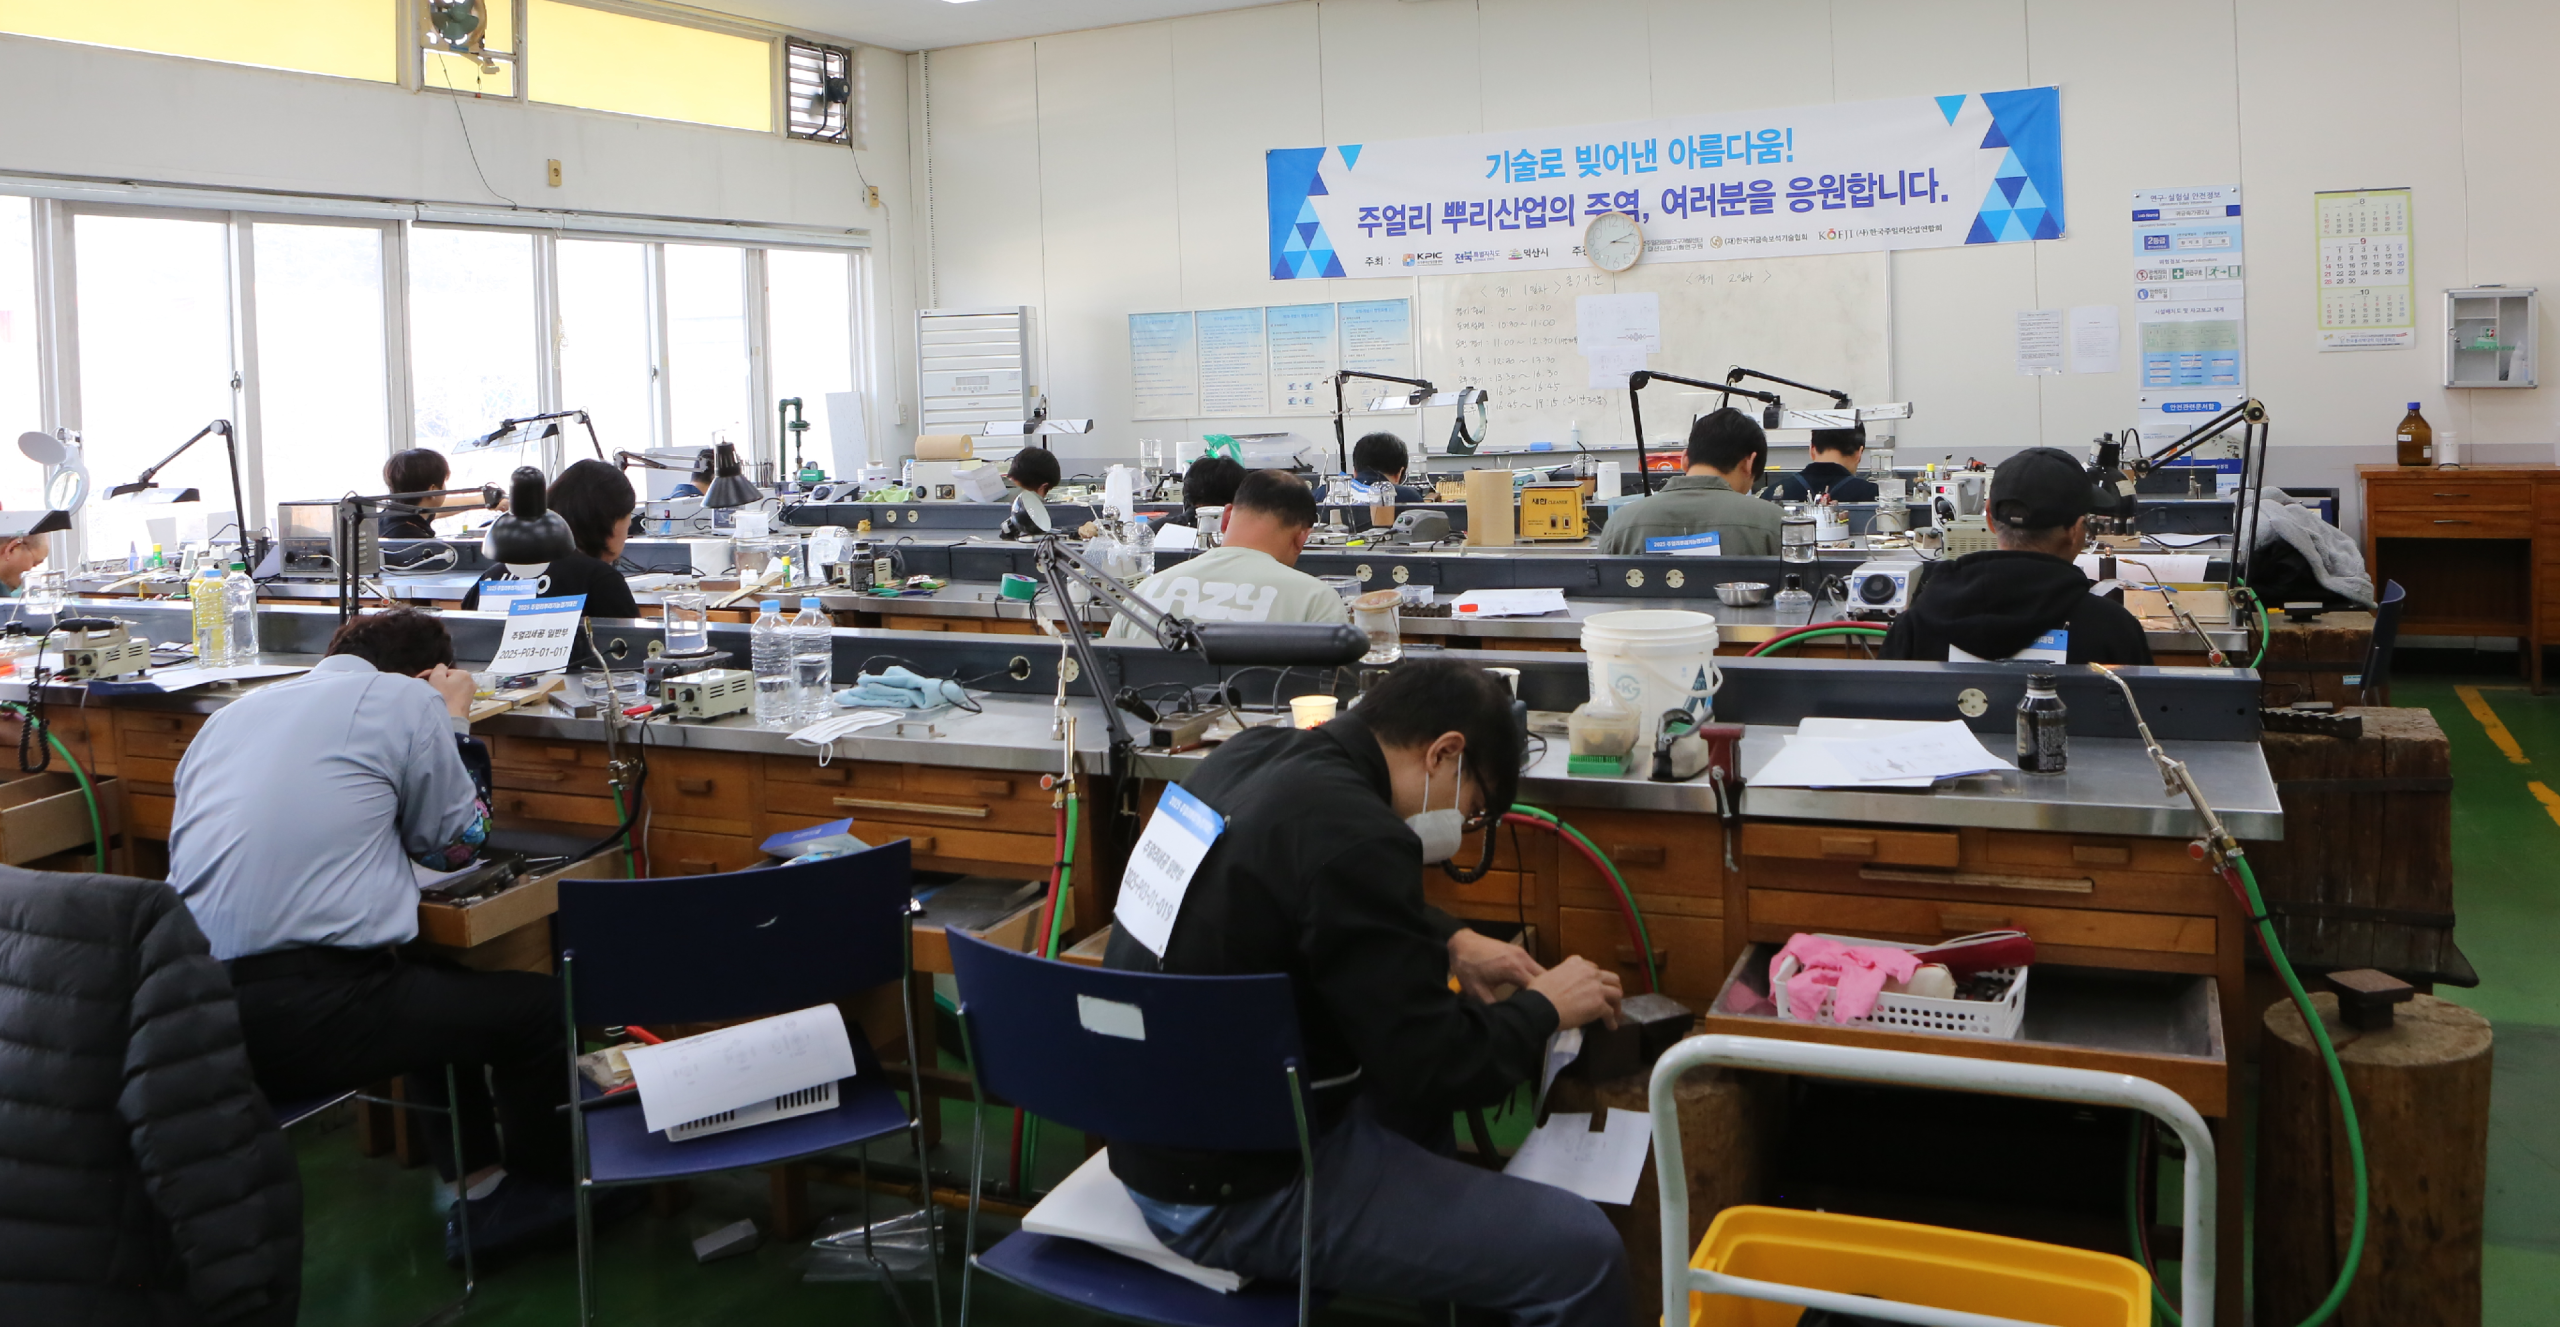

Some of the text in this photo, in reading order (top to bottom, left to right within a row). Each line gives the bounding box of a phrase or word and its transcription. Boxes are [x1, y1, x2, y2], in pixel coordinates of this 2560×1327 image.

[1485, 127, 1794, 184] 기술로 빚어낸 아름다움!
[1358, 168, 1949, 238] 주얼리 뿌리산업의 주역, 여러분을 응원합니다.
[1365, 256, 1384, 267] 주최
[1417, 252, 1443, 260] KPIC
[1523, 248, 1549, 257] 익산시
[1140, 576, 1278, 622] LAZY
[511, 628, 569, 641] 주얼리세공 일반부
[498, 646, 569, 660] 2025-P03-01-017
[1142, 839, 1186, 883] 주얼리세공 일반부
[1124, 867, 1174, 922] 2025-P03-01-019
